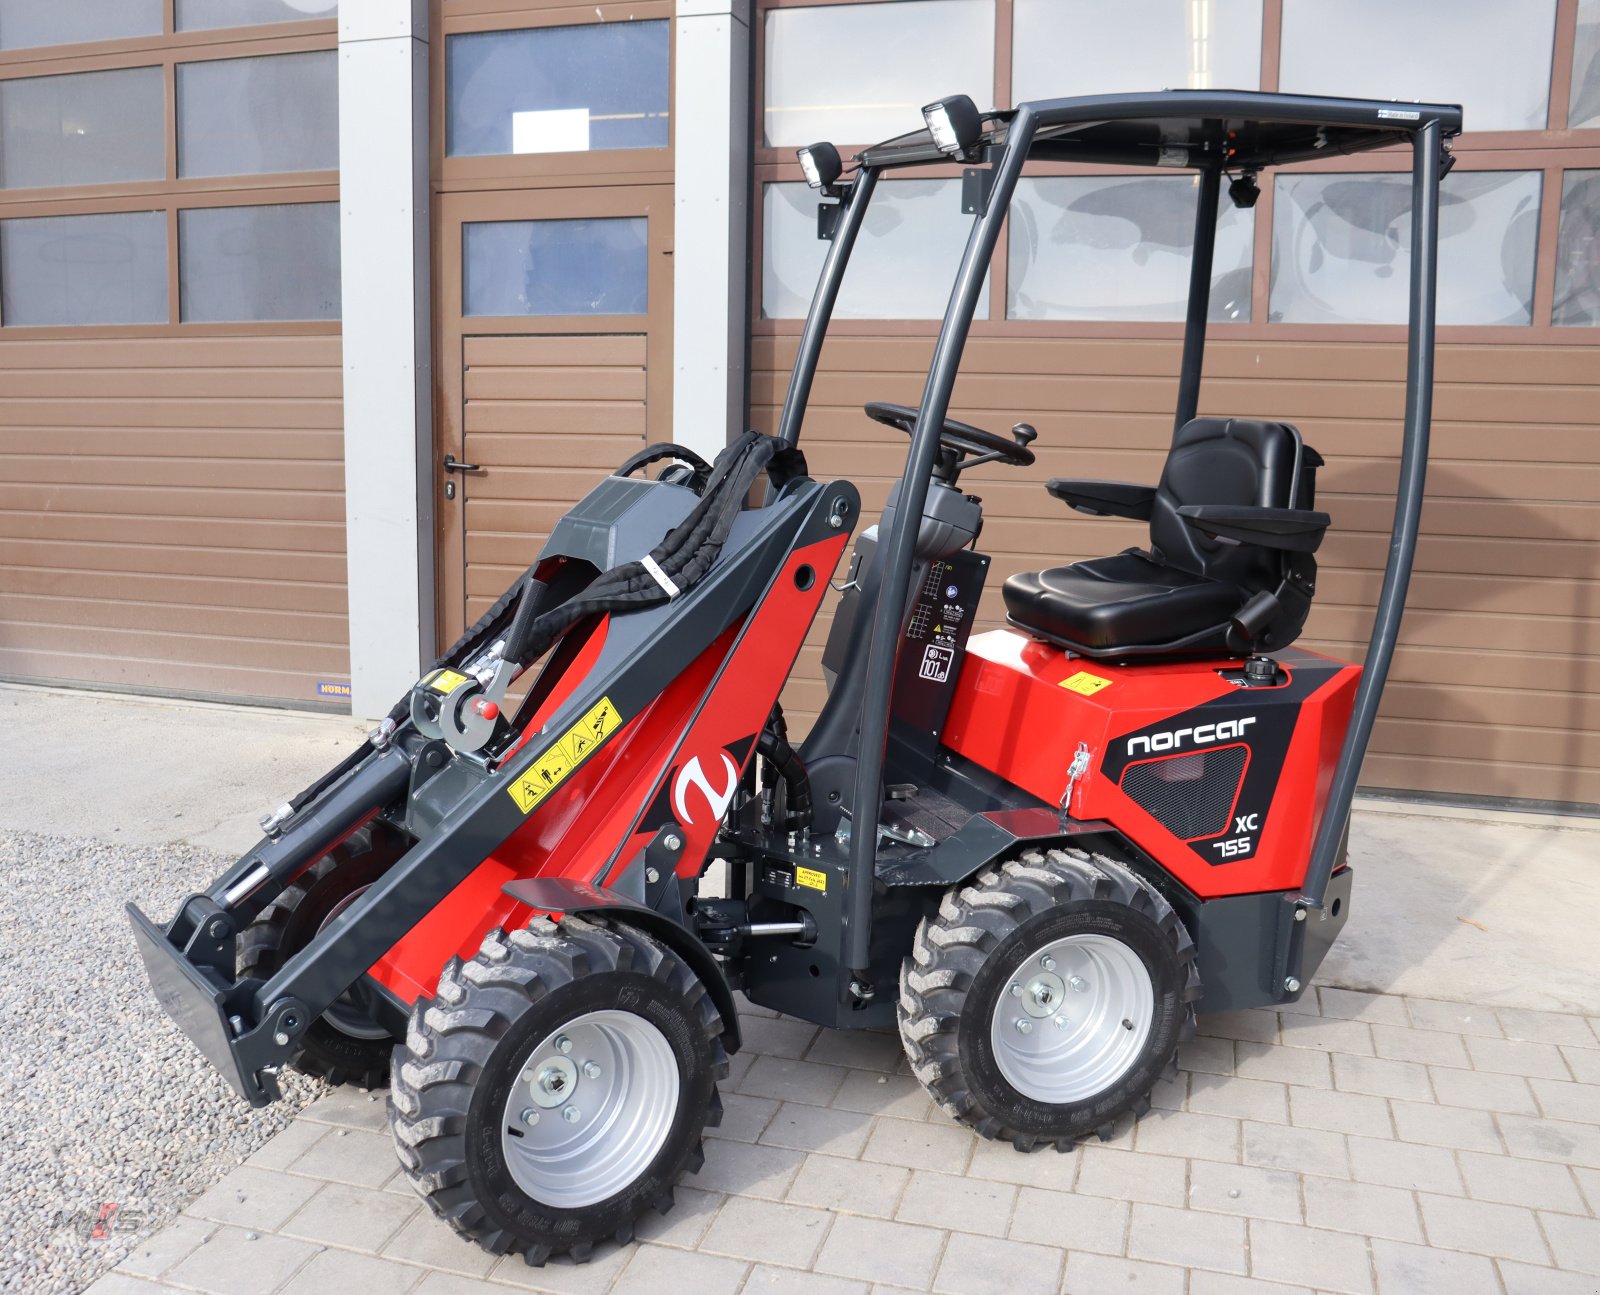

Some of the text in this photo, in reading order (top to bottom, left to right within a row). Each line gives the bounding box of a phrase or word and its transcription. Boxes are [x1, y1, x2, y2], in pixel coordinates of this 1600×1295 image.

[924, 659, 940, 678] 101
[321, 683, 352, 695] HÖRM
[1127, 716, 1256, 756] norcar
[1235, 813, 1258, 833] XC
[1213, 837, 1251, 857] 755
